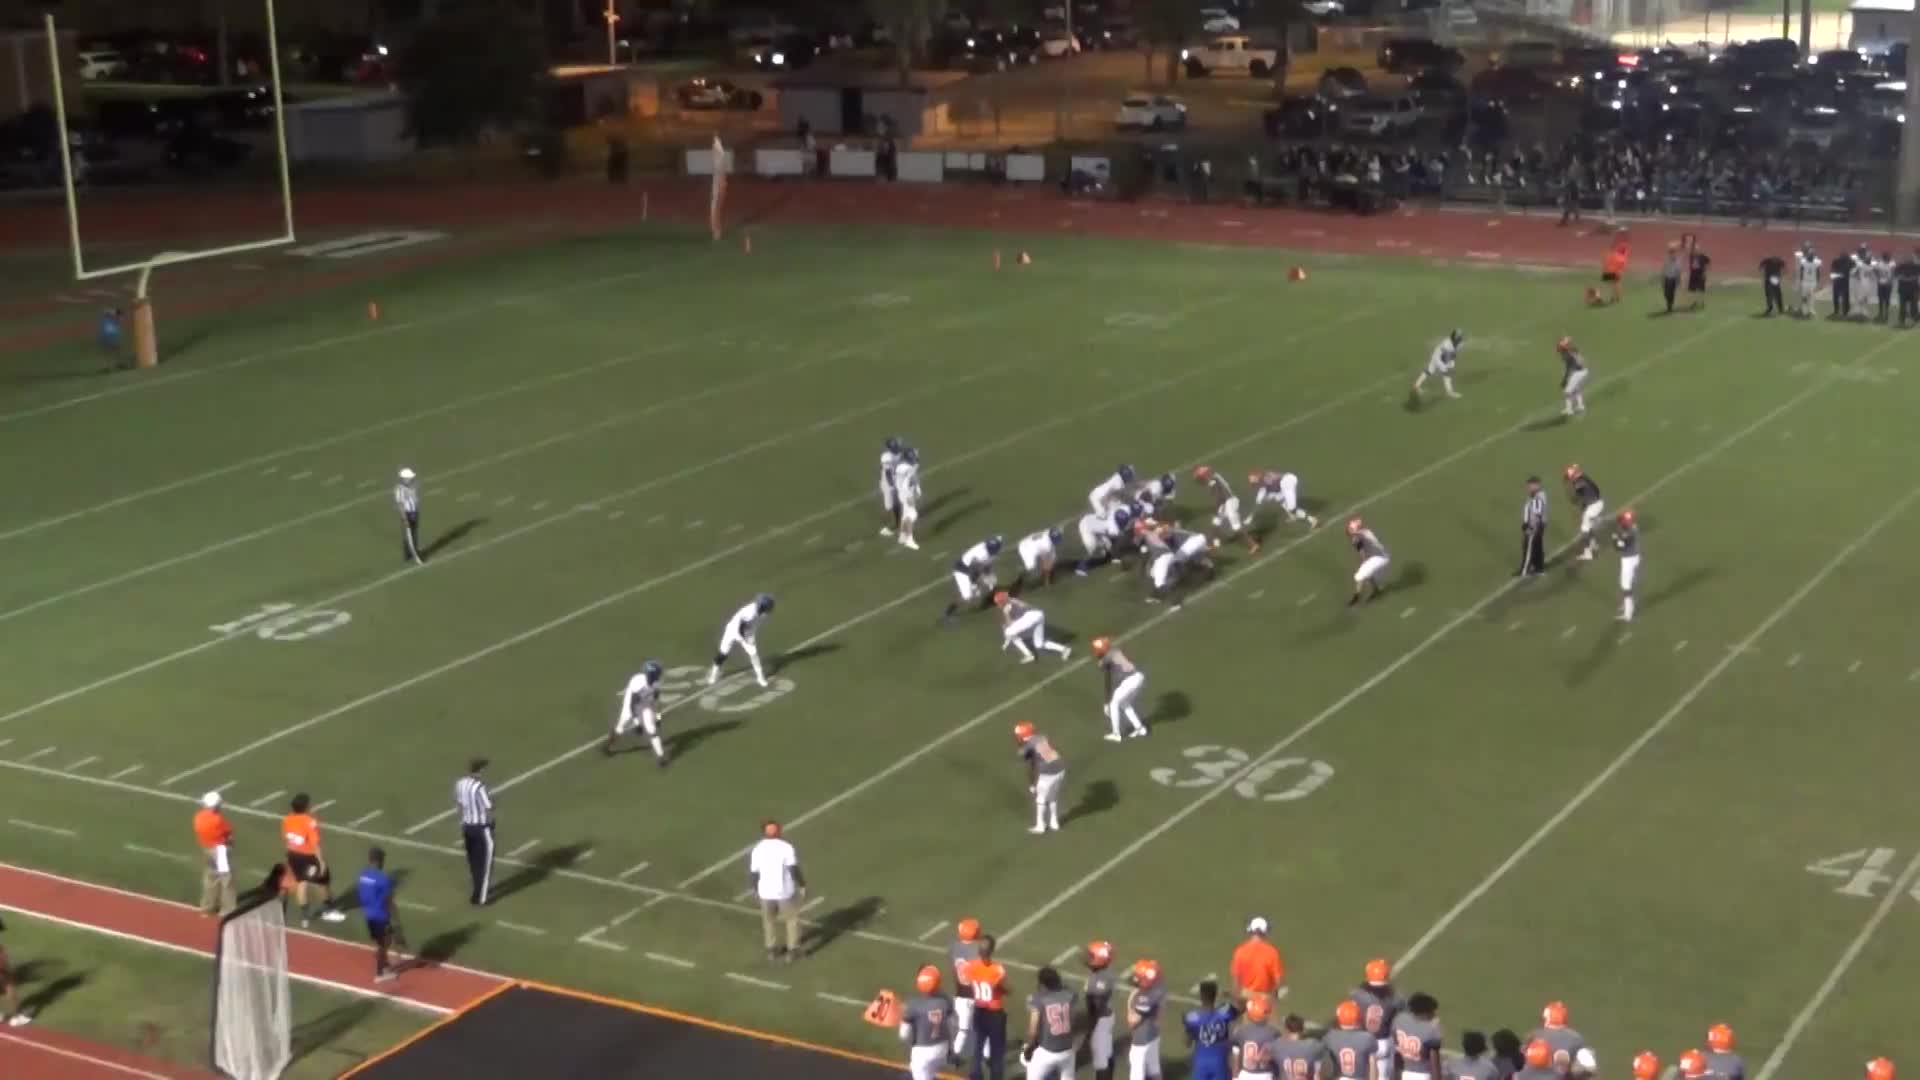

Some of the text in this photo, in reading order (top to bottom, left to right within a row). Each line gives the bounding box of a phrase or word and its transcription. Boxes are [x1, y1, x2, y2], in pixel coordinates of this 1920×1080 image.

[209, 602, 351, 640] 10
[1150, 745, 1335, 800] 30
[1805, 847, 1920, 904] 4
[1045, 1002, 1071, 1036] 51
